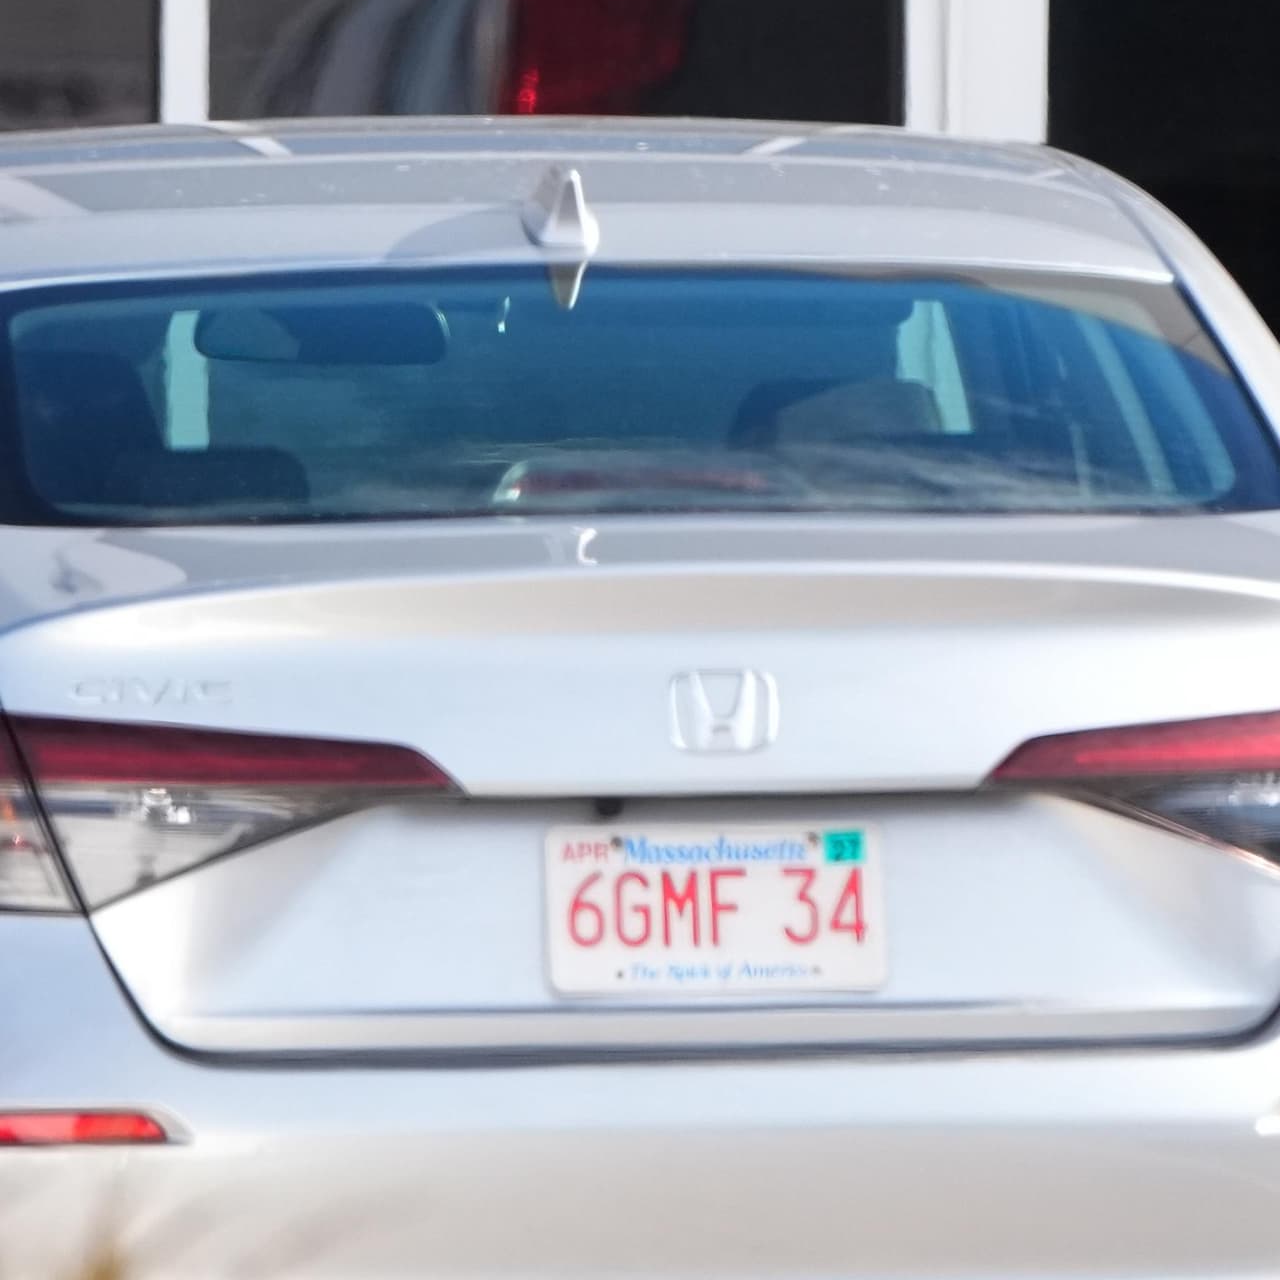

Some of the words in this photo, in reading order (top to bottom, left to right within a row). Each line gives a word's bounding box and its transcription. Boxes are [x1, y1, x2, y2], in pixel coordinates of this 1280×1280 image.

[69, 677, 234, 705] CIVIC
[561, 841, 609, 863] APR
[623, 835, 807, 864] Massachusetts
[568, 868, 747, 948] 6GMF
[781, 867, 868, 944] 34
